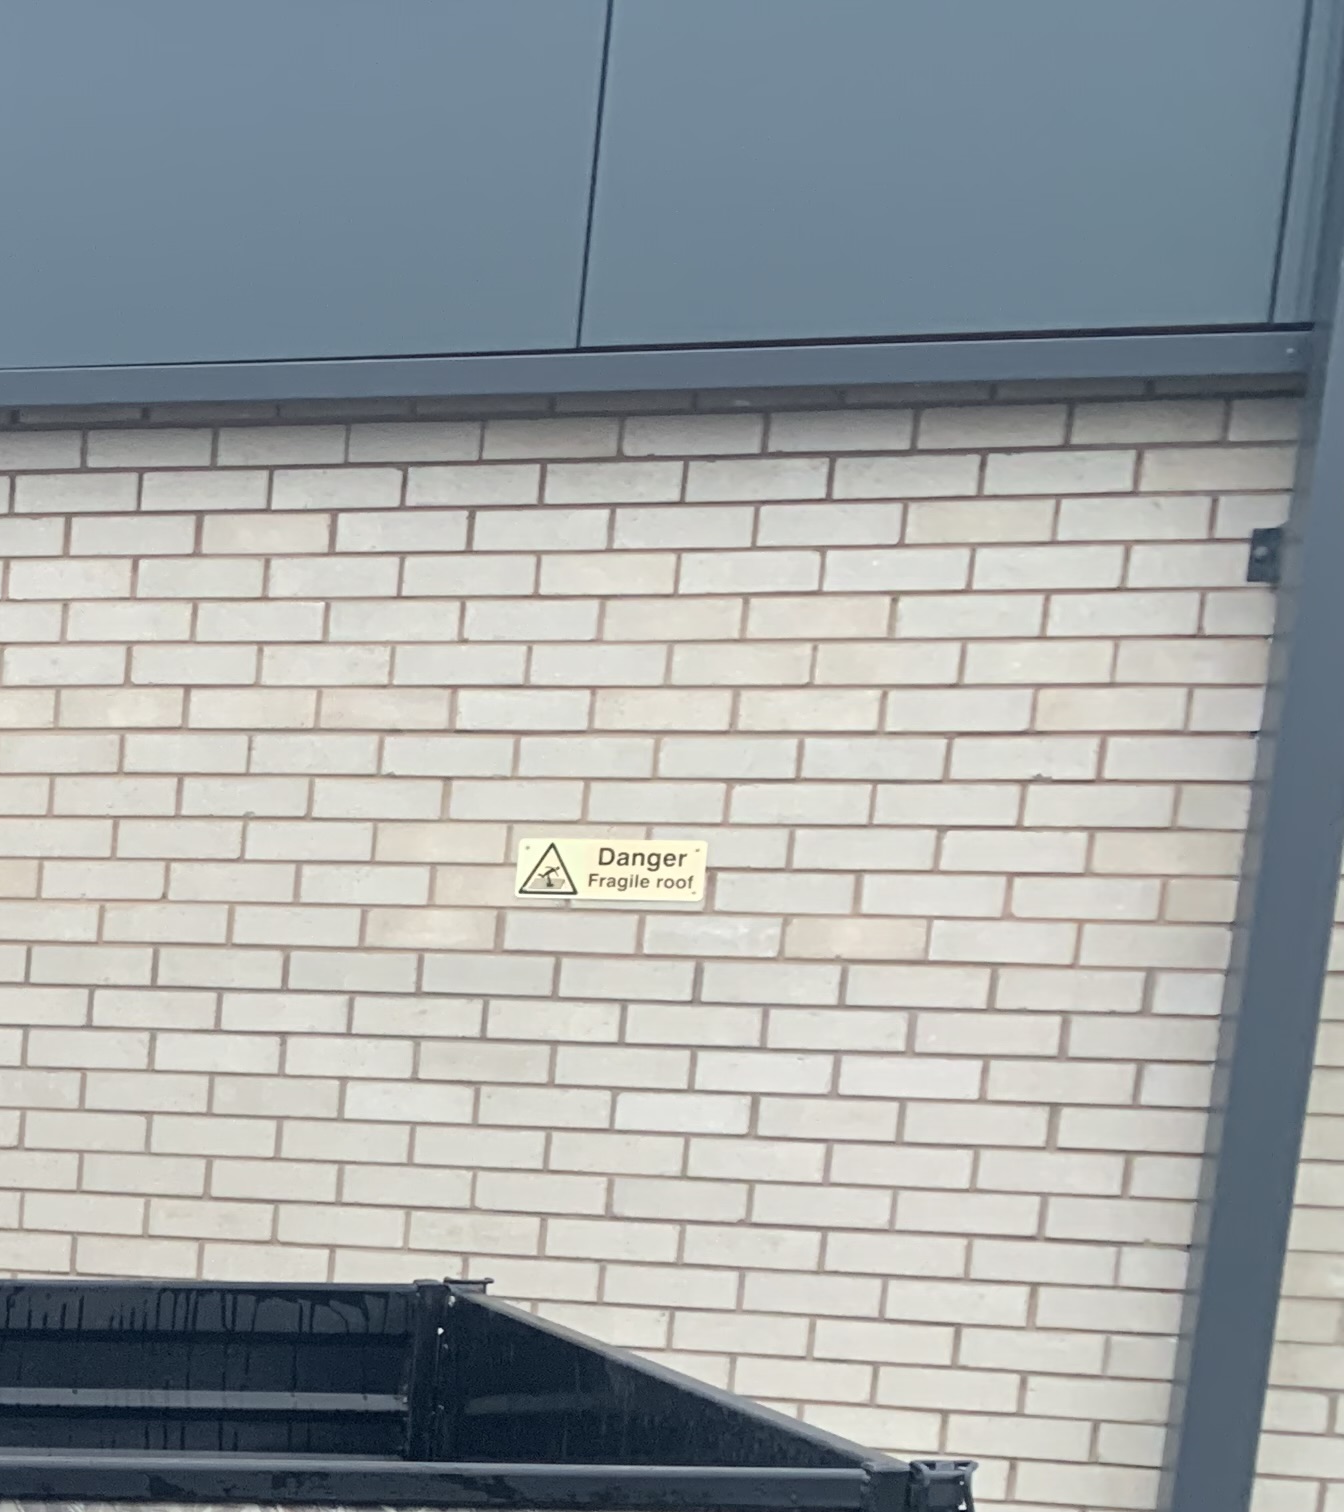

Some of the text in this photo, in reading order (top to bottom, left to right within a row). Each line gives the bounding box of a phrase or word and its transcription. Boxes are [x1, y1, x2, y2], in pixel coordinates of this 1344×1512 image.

[598, 847, 688, 871] Danger
[588, 873, 694, 892] Fragile roof
